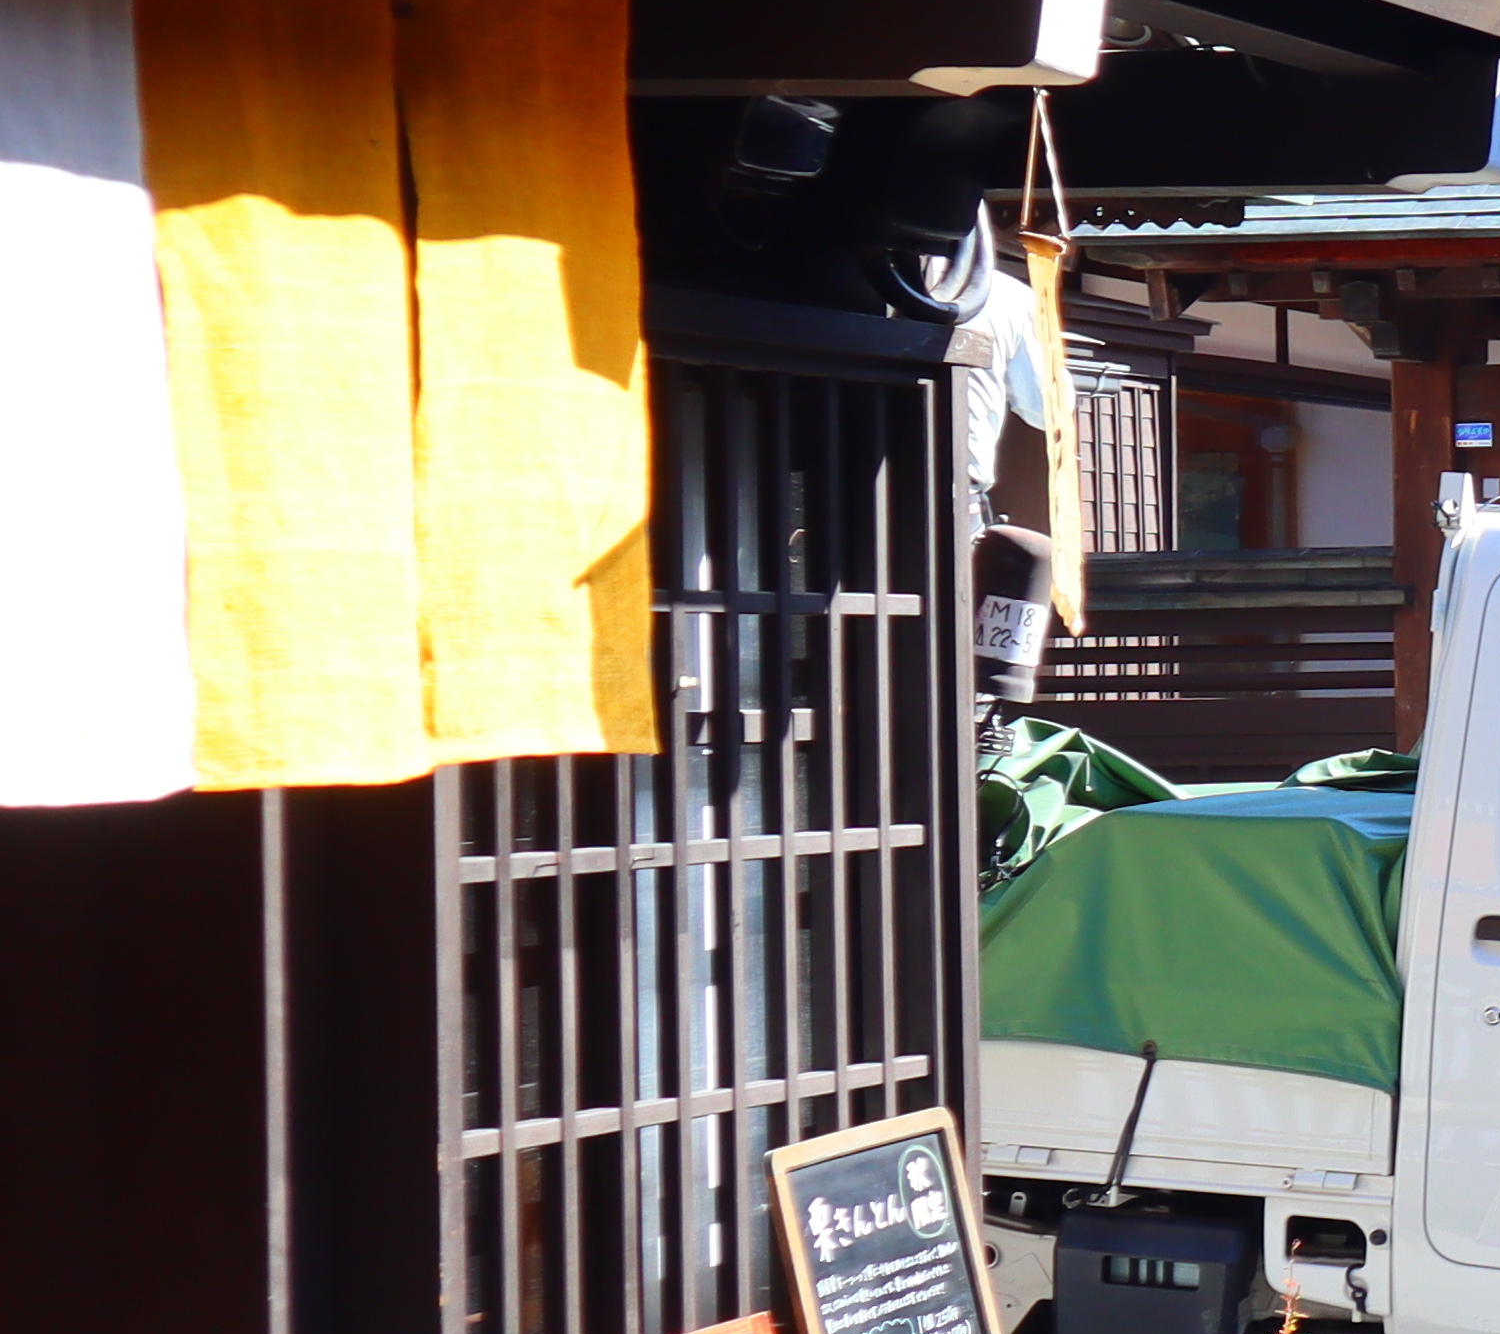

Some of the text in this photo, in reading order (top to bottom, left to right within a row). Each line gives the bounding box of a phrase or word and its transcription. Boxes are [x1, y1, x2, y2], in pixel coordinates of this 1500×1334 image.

[807, 1193, 907, 1263] 栗きんとん
